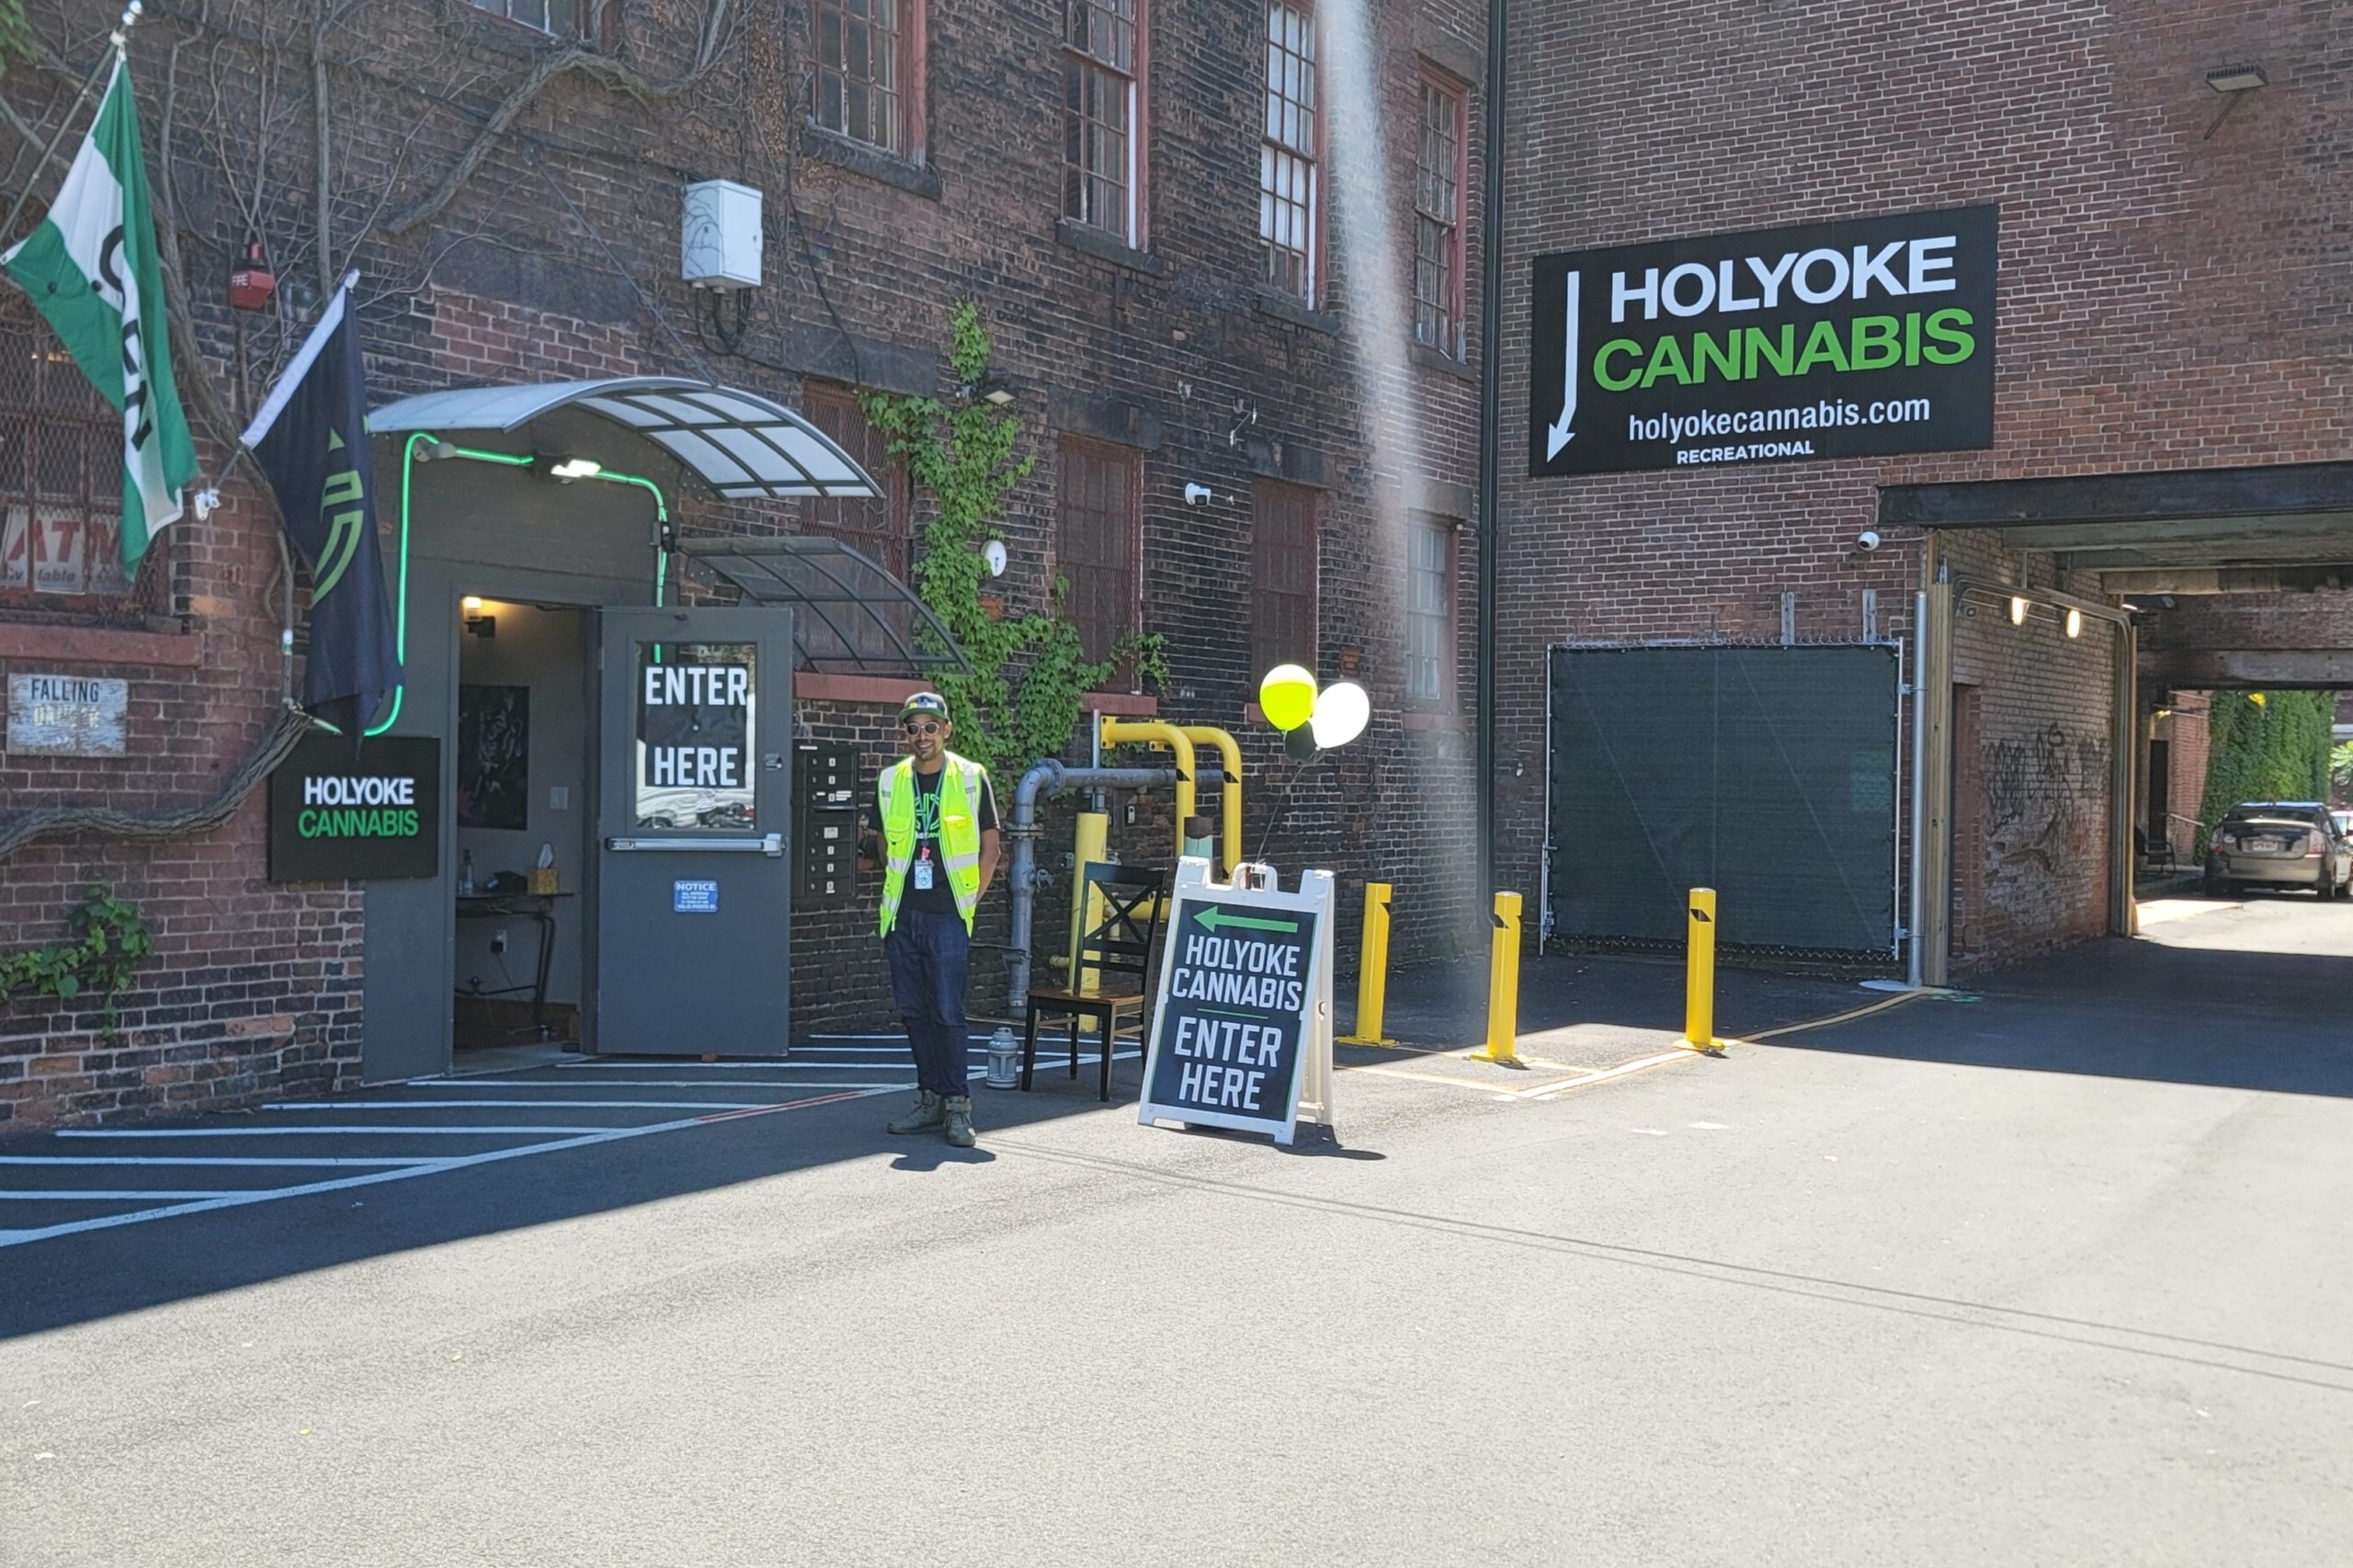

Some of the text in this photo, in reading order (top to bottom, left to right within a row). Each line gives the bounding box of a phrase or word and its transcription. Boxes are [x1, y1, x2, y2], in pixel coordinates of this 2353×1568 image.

[232, 274, 249, 286] FIRE
[1610, 235, 1957, 324] HOLYOKE
[99, 223, 153, 452] OEN
[1592, 307, 1976, 392] CANNABIS
[1629, 397, 1930, 444] holyokecannabis.com
[1677, 440, 1814, 464] RECREATIONAL
[30, 678, 99, 702] FALLING
[645, 666, 748, 706] ENTER
[654, 746, 738, 787] HERE
[304, 777, 415, 805] HOLYOKE
[299, 810, 419, 838] CANNABIS
[676, 882, 716, 892] NOTICE
[1185, 934, 1301, 977] HOLYOKE
[1172, 968, 1302, 1012] CANNABIS
[1174, 1016, 1283, 1068] ENTER
[1178, 1062, 1266, 1110] HERE
